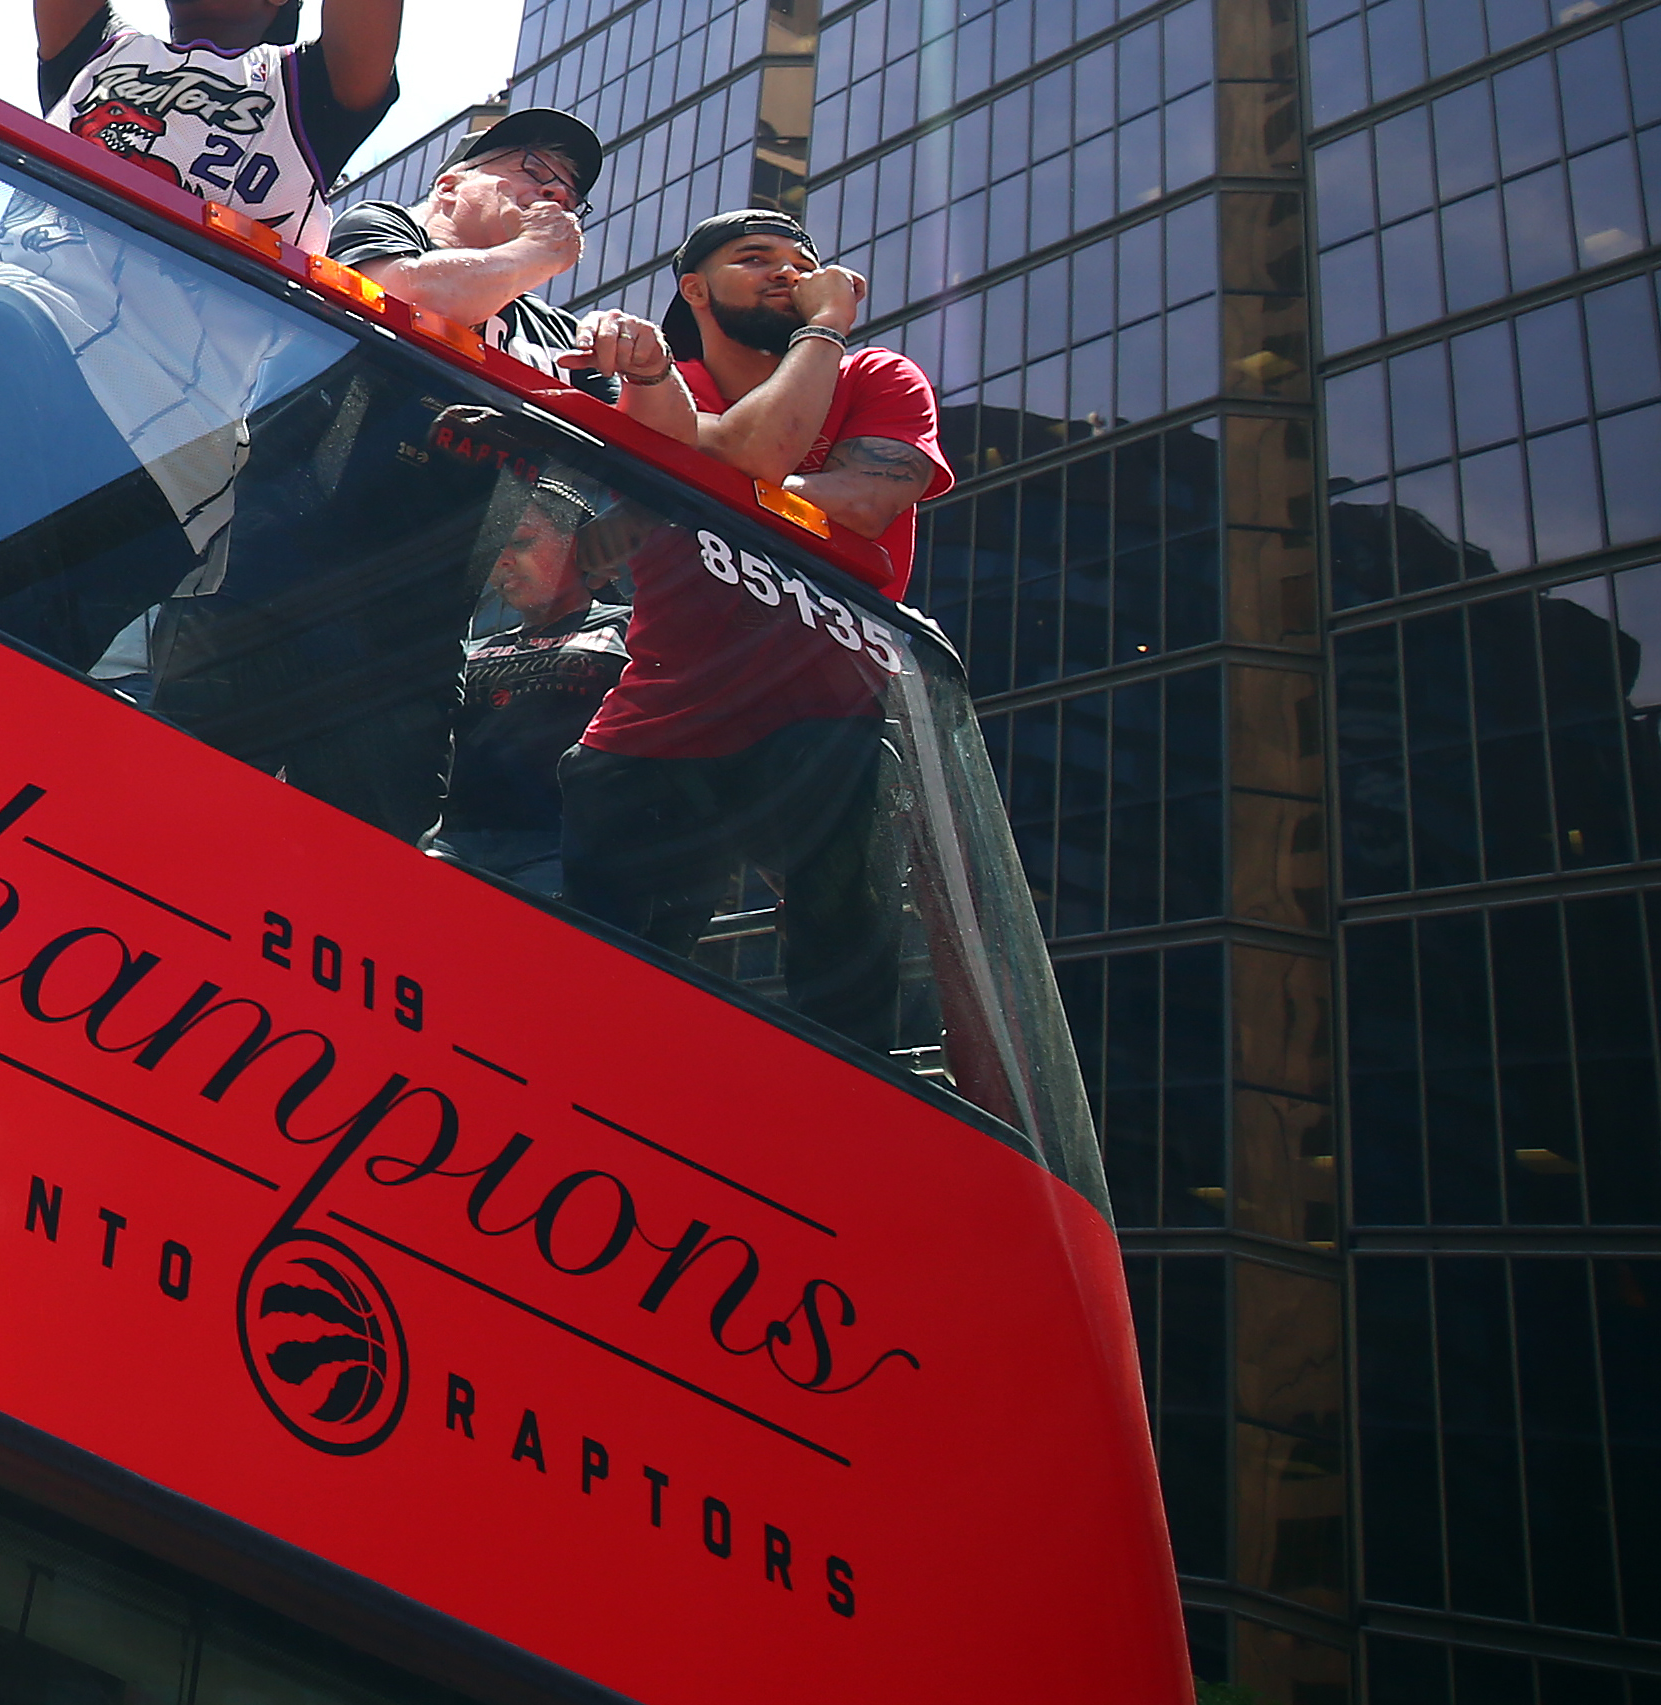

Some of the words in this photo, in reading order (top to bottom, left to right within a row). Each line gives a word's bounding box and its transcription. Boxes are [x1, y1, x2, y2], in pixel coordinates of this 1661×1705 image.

[189, 133, 280, 204] 20
[696, 529, 901, 675] 85135
[261, 909, 425, 1034] 2019
[446, 1370, 856, 1618] RAPTORS
